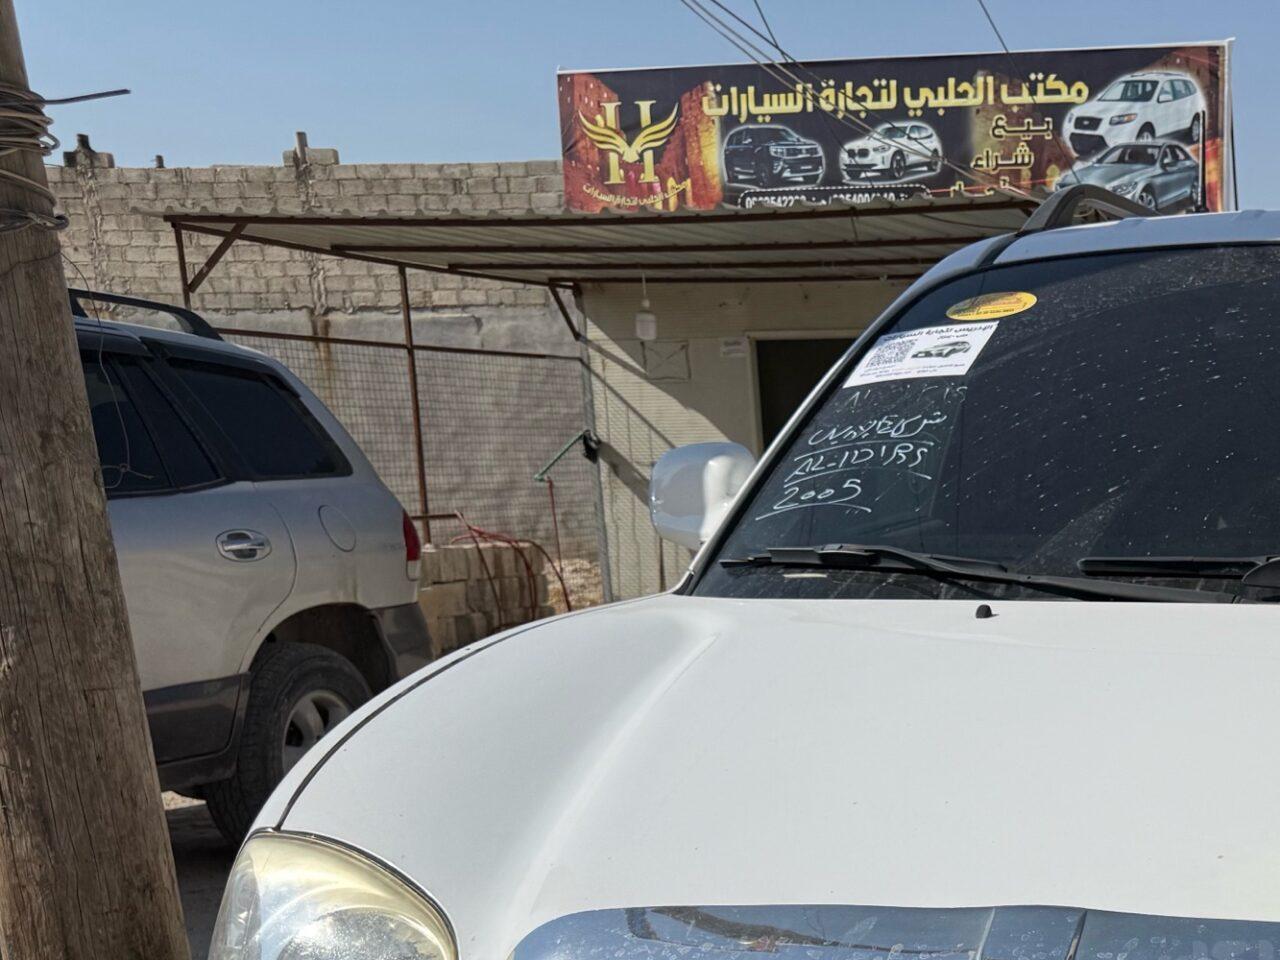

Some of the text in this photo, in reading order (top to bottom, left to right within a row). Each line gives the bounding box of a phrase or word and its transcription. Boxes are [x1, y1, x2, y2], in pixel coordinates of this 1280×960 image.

[702, 73, 1089, 122] مكتب الحلبي لتجارة السيارات
[991, 114, 1053, 139] بيع
[971, 142, 1034, 174] شراء
[772, 478, 862, 510] 2005
